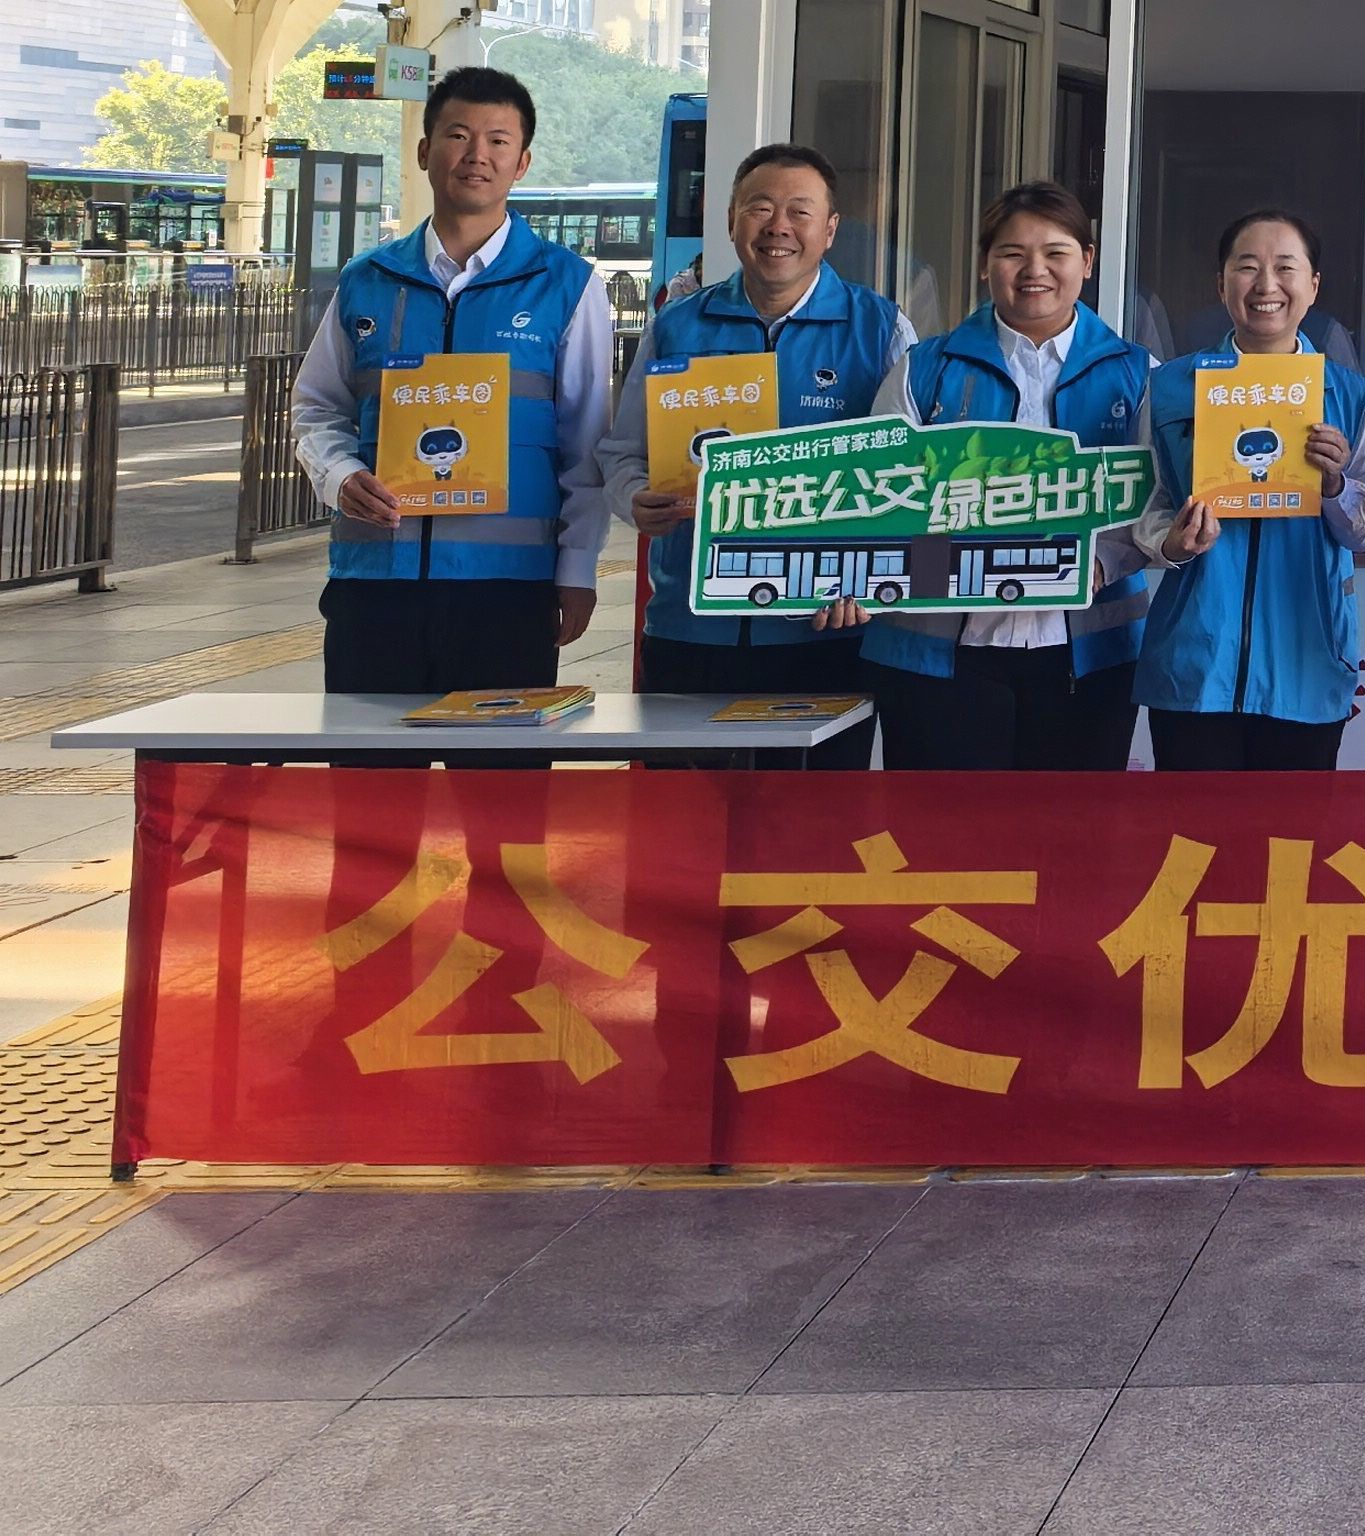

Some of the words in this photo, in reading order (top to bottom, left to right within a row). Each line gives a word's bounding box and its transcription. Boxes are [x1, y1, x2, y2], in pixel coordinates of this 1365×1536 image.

[712, 427, 909, 472] 济南公交出行管家邀您
[708, 462, 929, 533] 优选公交
[925, 458, 1146, 533] 绿色出行
